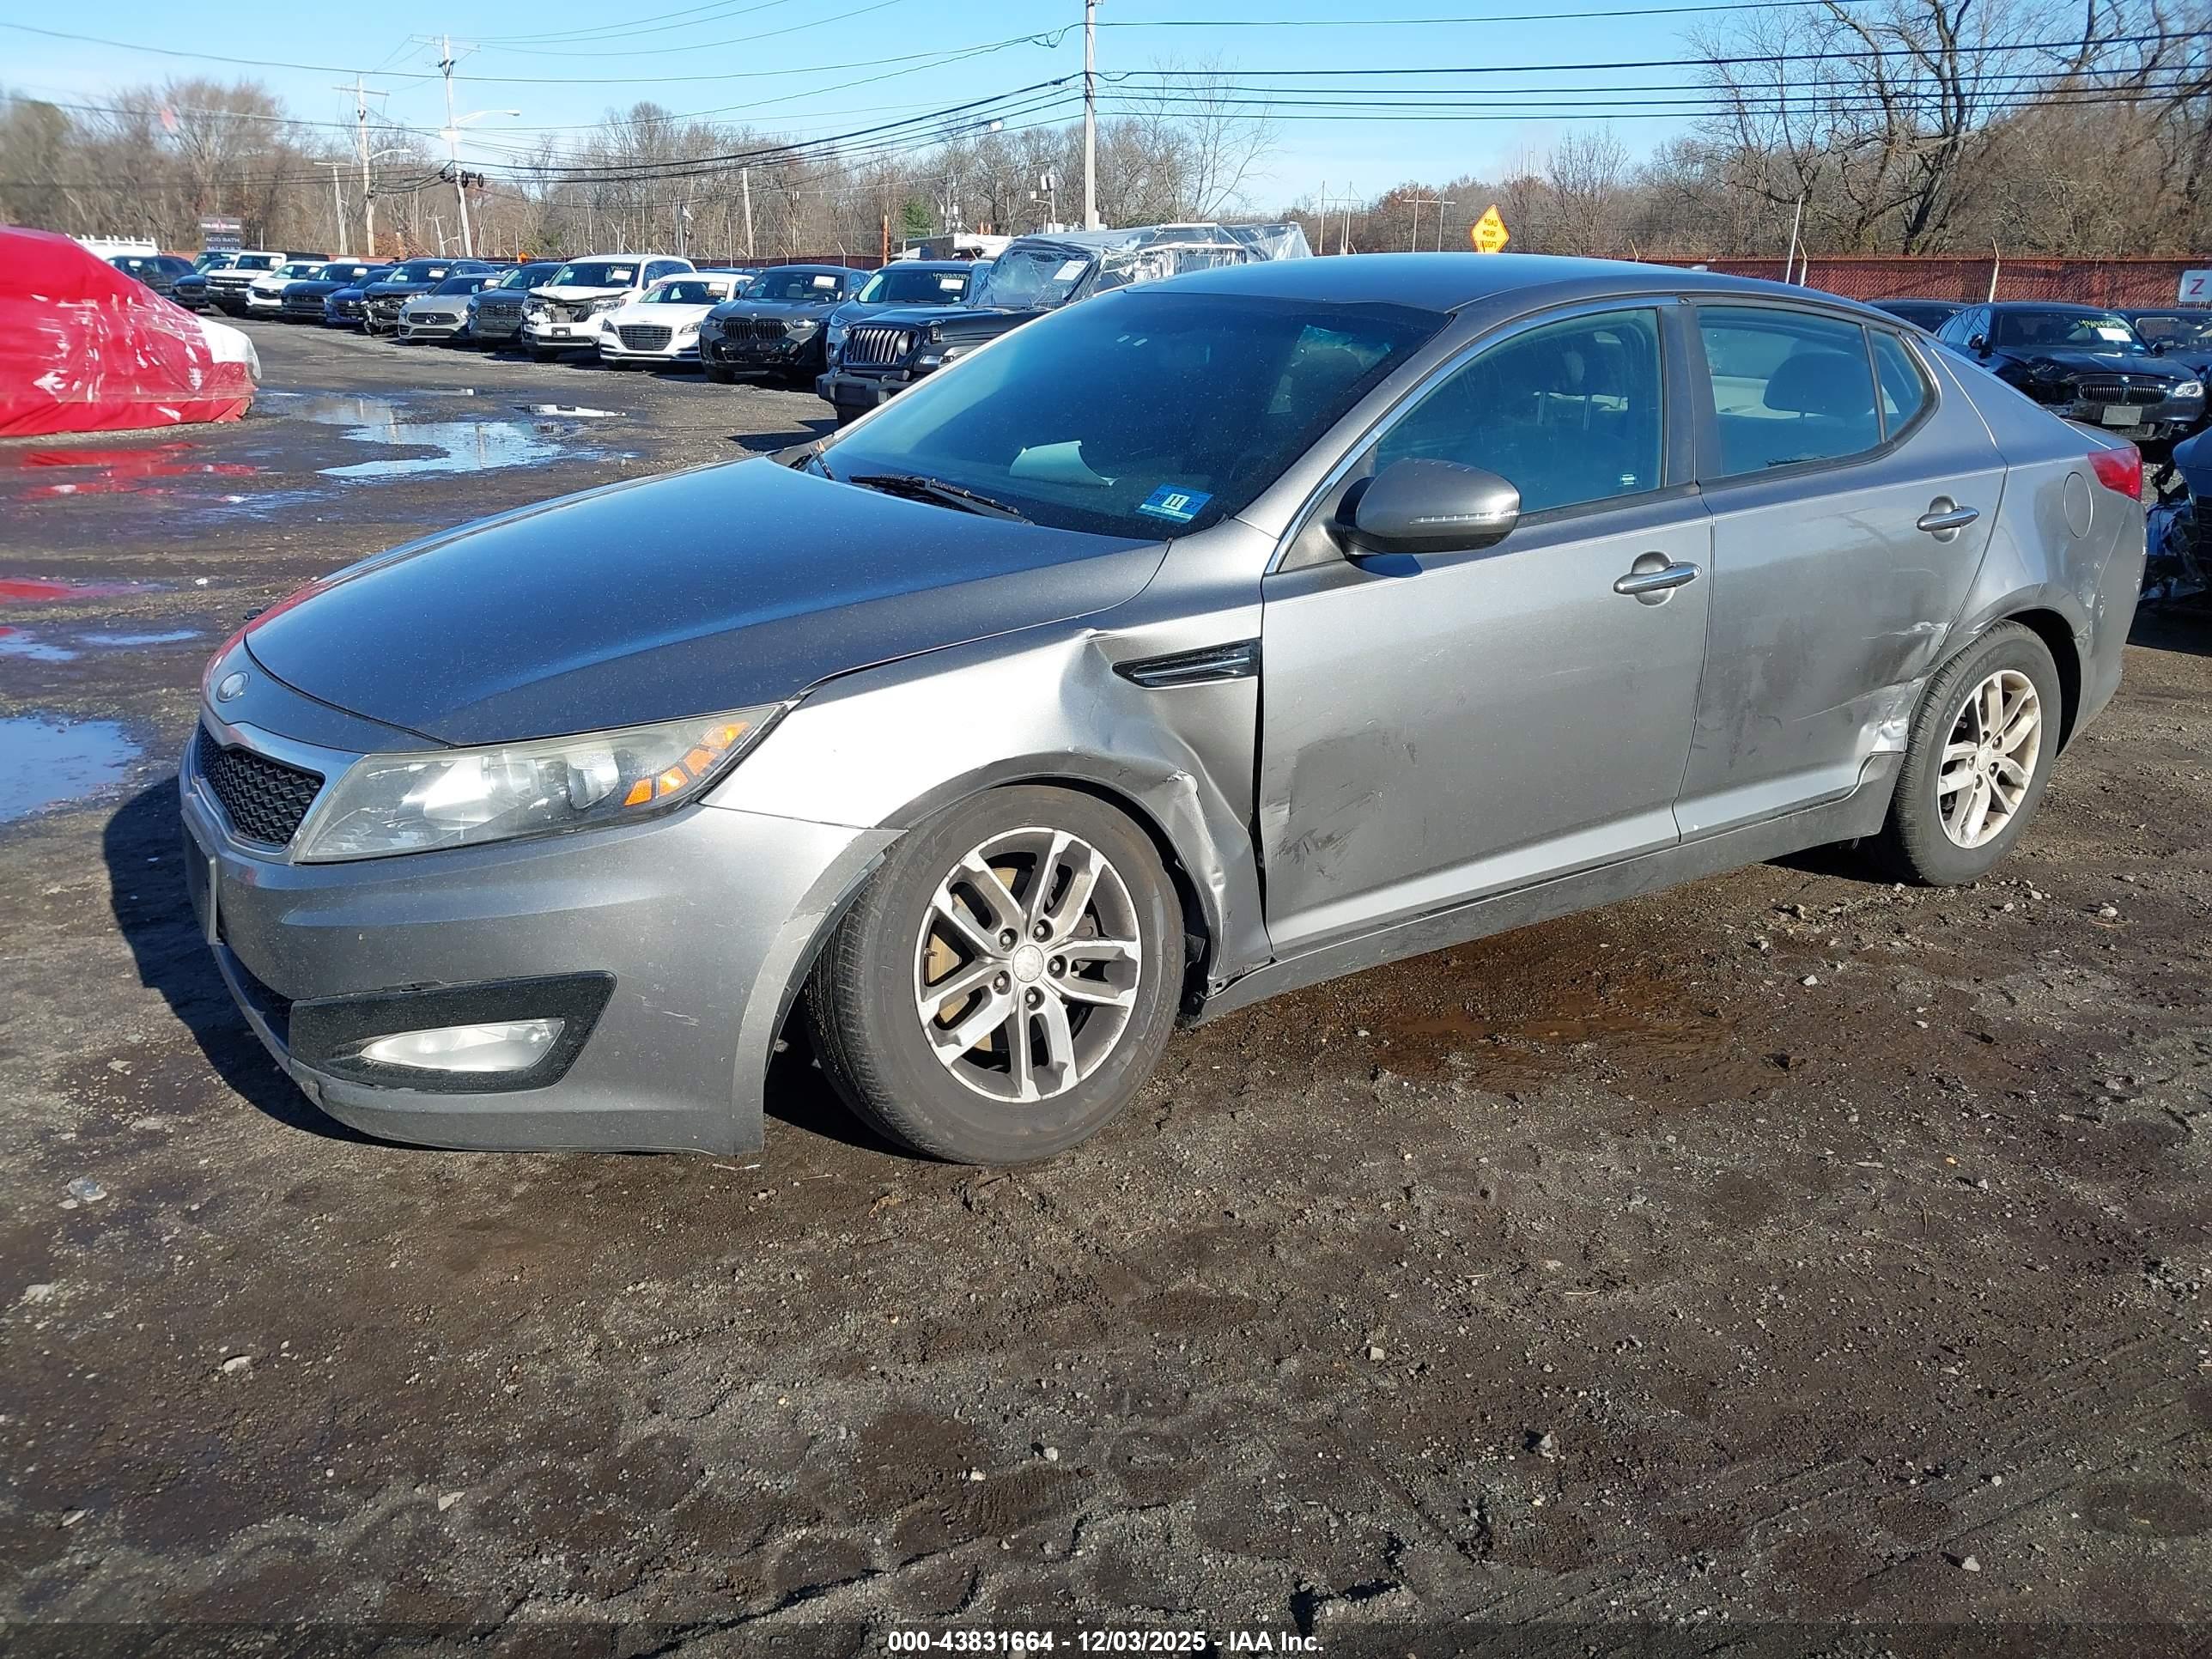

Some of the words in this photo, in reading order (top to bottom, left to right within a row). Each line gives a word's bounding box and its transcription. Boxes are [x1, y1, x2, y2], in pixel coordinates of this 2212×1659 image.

[1484, 218, 1498, 227] ROAD
[2191, 279, 2205, 295] Z
[1165, 495, 1184, 507] 11
[1944, 659, 1986, 721] OPTIMUM
